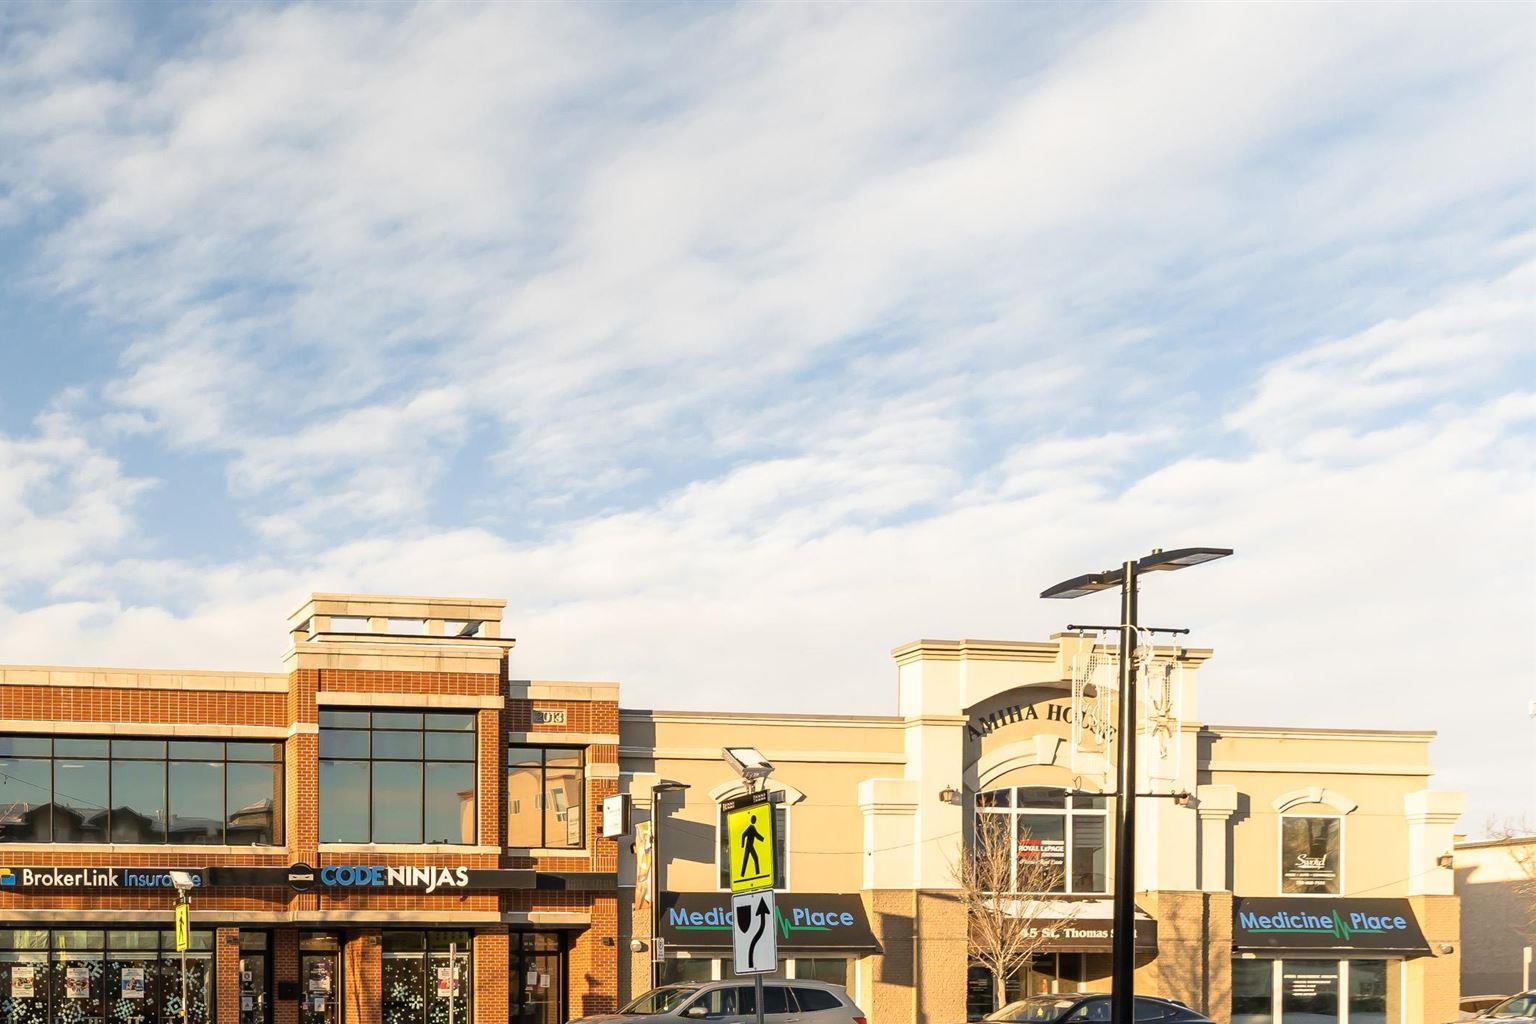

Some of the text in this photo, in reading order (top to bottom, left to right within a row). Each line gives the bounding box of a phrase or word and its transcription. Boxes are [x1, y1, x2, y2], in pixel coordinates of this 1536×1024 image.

[533, 711, 564, 723] 2013
[967, 704, 1038, 742] AMIHA
[23, 868, 201, 887] BrokerLink Insurae
[321, 865, 469, 893] CODE NINJAS
[669, 908, 854, 926] Medic Place
[1240, 912, 1407, 930] Medicine Place
[1064, 928, 1108, 938] Thomas
